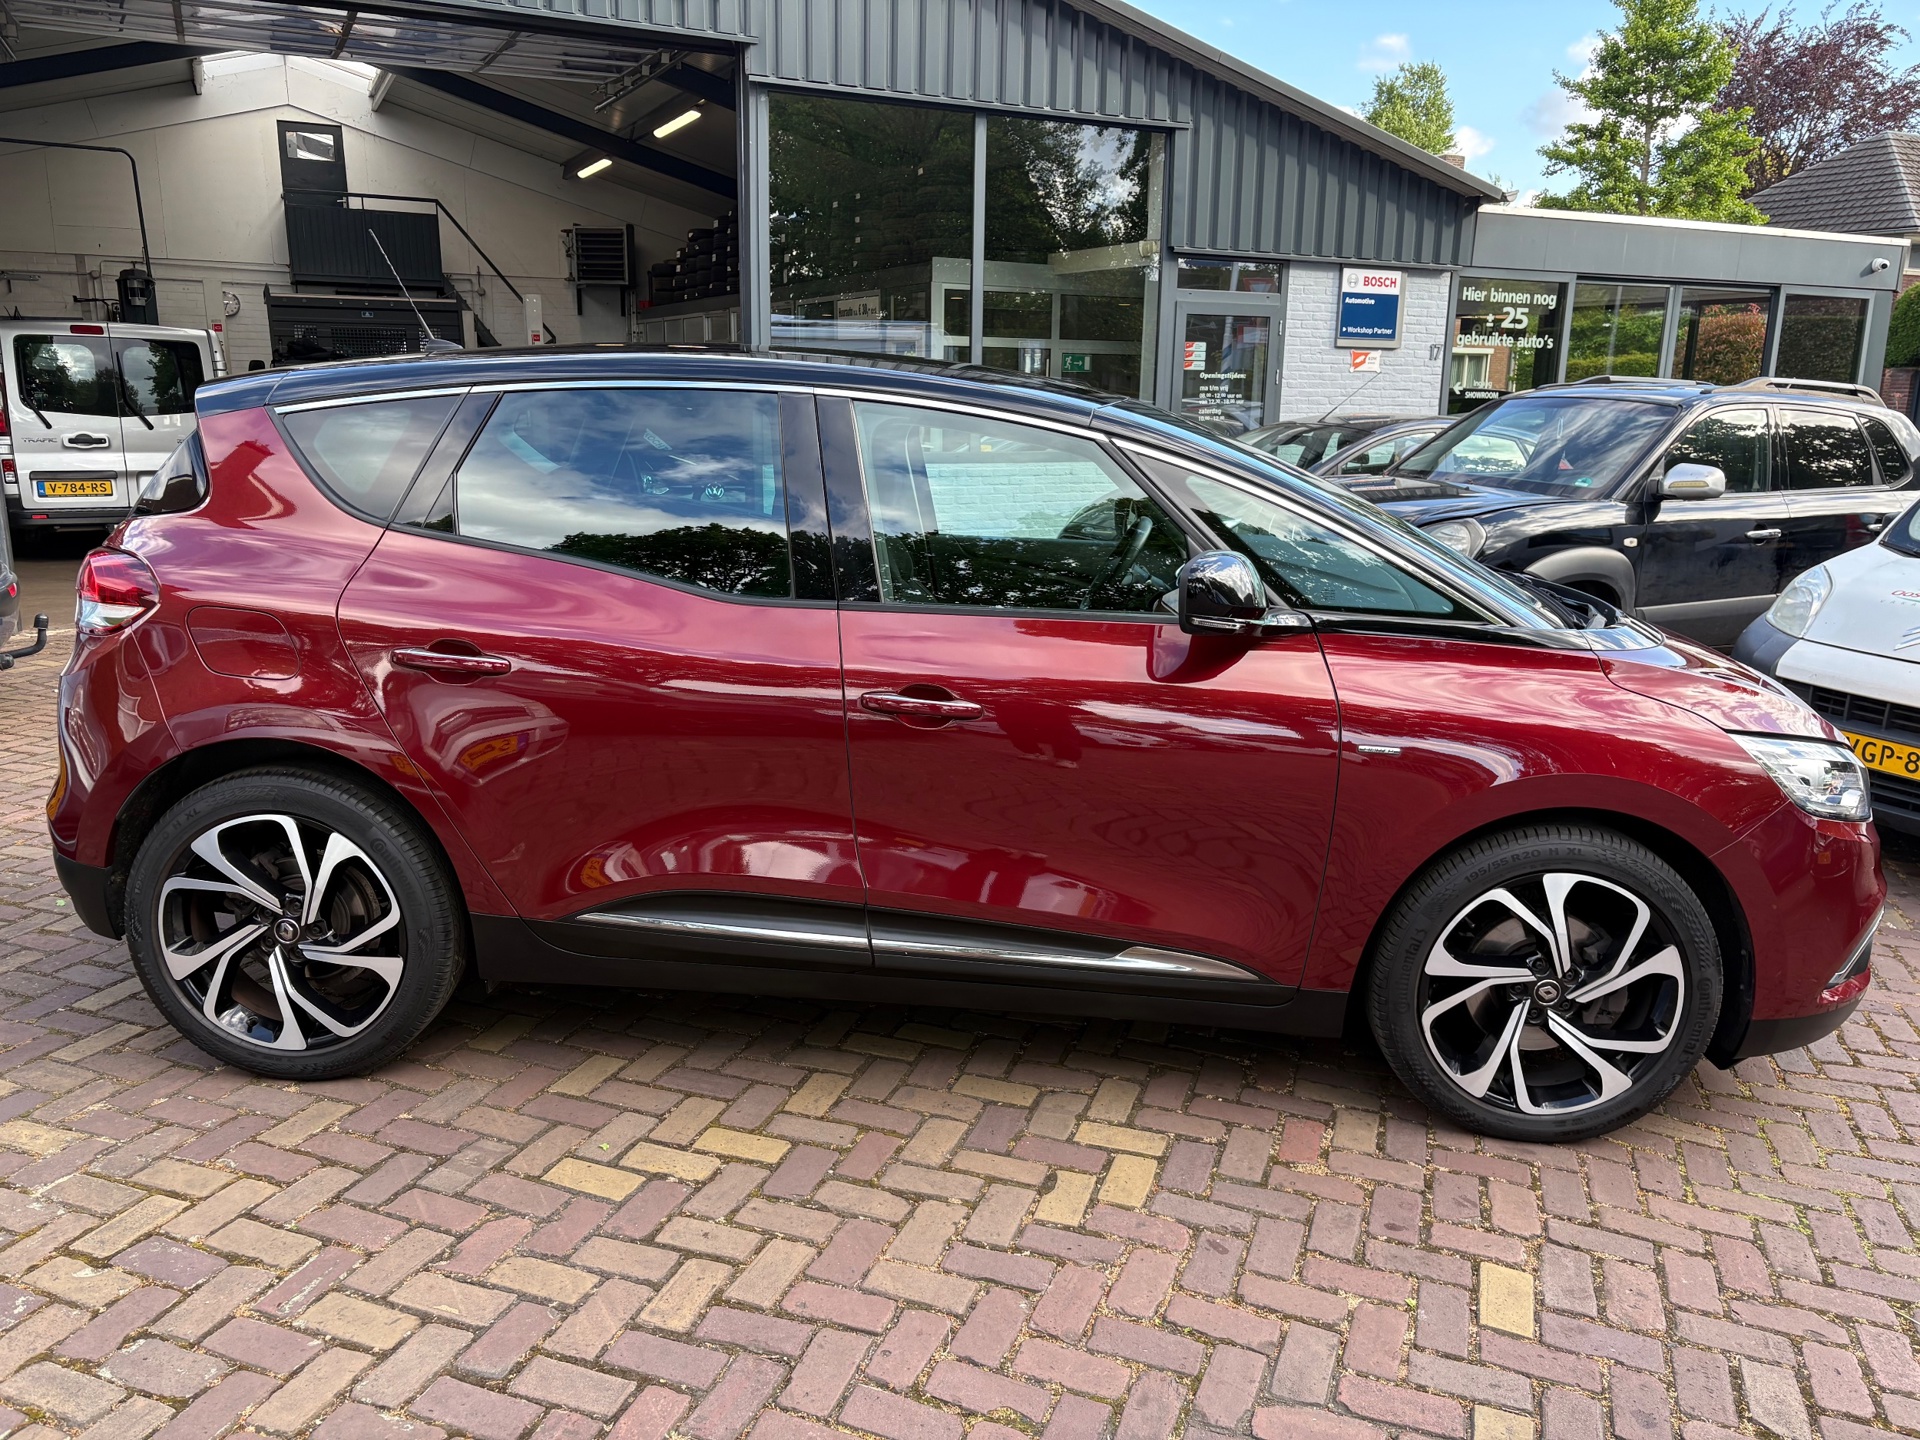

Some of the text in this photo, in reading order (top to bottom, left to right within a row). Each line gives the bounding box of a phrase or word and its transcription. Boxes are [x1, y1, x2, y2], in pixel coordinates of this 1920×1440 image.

[1363, 276, 1397, 288] BOSCH
[1345, 296, 1375, 305] Automotive
[1462, 286, 1557, 310] Hier binnen nog
[1501, 306, 1529, 330] 25
[1347, 326, 1393, 335] Workshop Partner
[1456, 331, 1554, 349] gebruikte auto's
[1428, 344, 1444, 361] 17
[1199, 371, 1247, 380] Openingstijden:
[1220, 384, 1229, 392] vrij
[1464, 390, 1499, 399] SHOWROOM
[49, 482, 107, 493] V-784-RS
[1464, 847, 1585, 883] 195/55 R20 H XL
